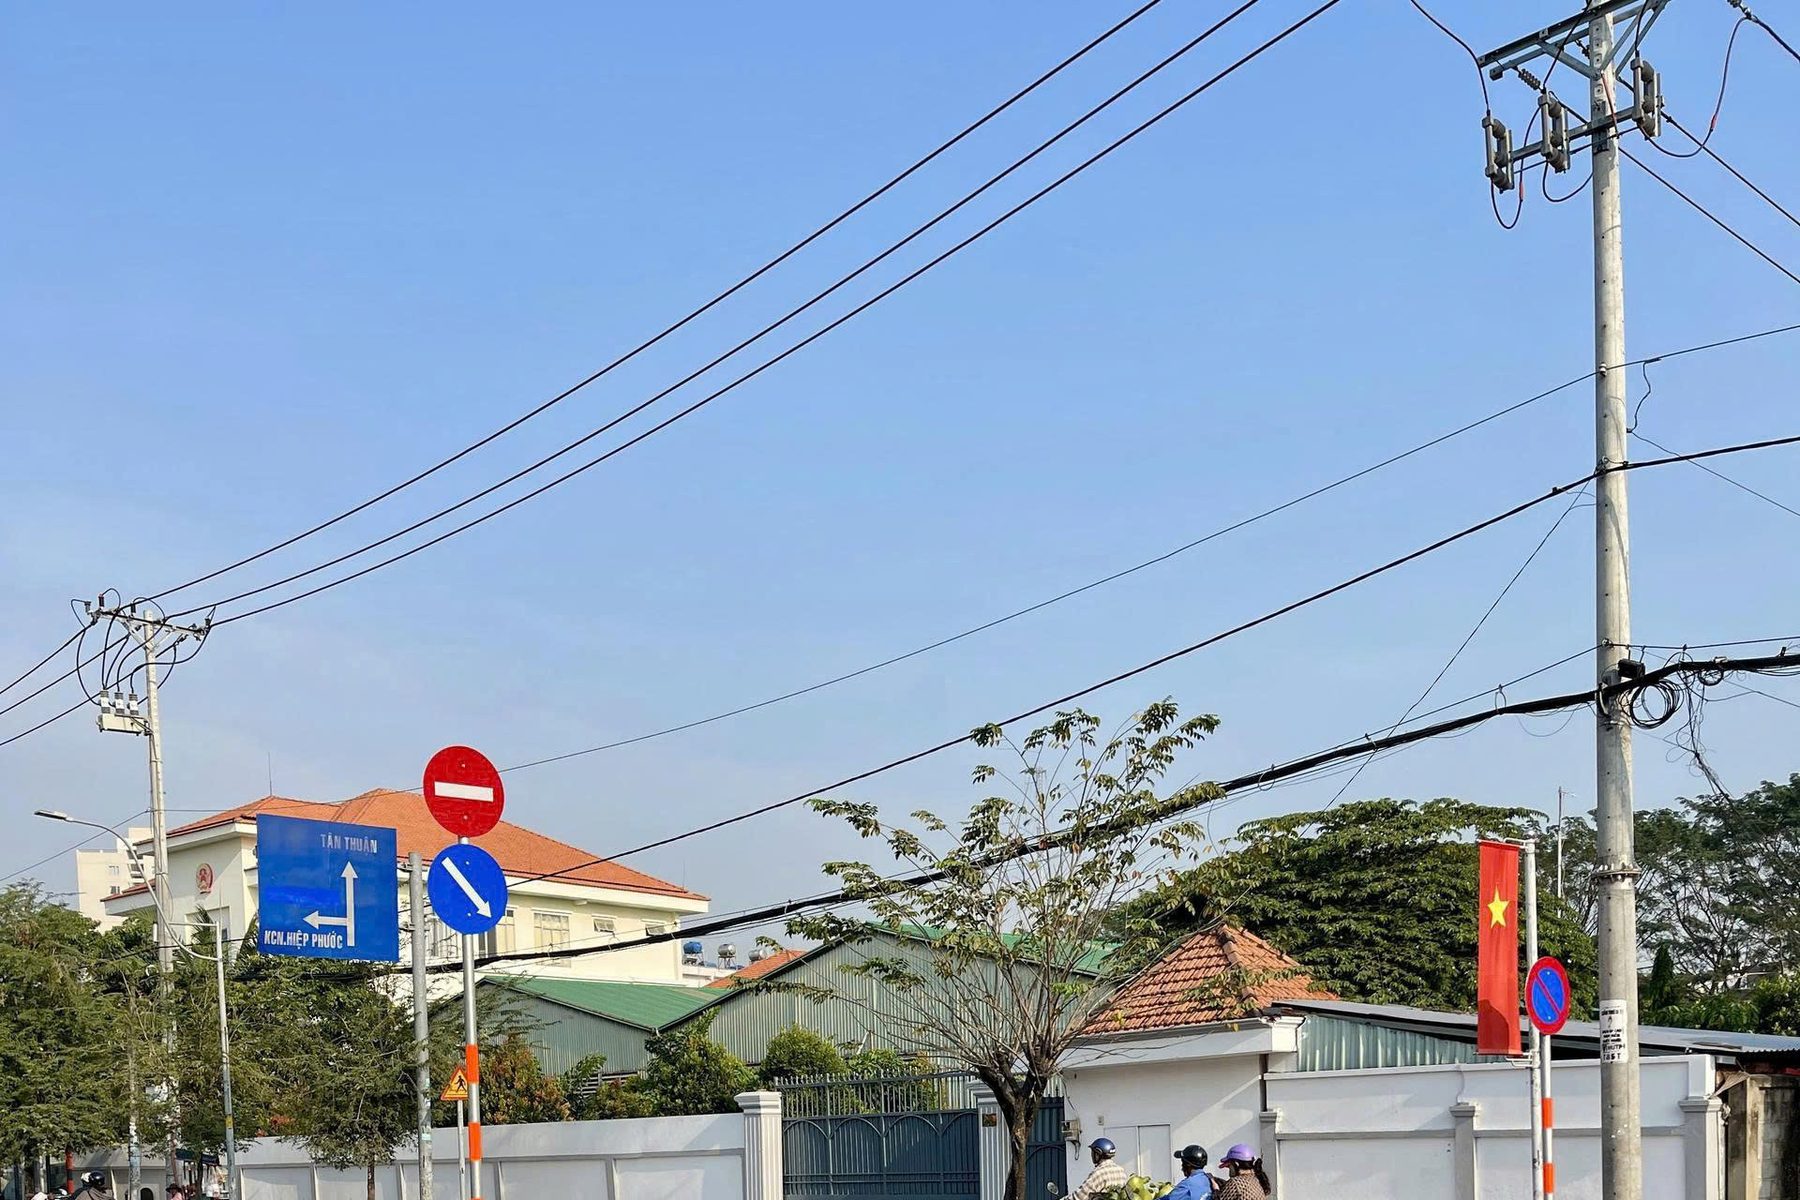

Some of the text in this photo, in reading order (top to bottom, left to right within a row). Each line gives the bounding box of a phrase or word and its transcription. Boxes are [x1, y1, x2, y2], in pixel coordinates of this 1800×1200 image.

[320, 832, 378, 856] TÂN THUẬN
[311, 931, 343, 949] PHƯỚC
